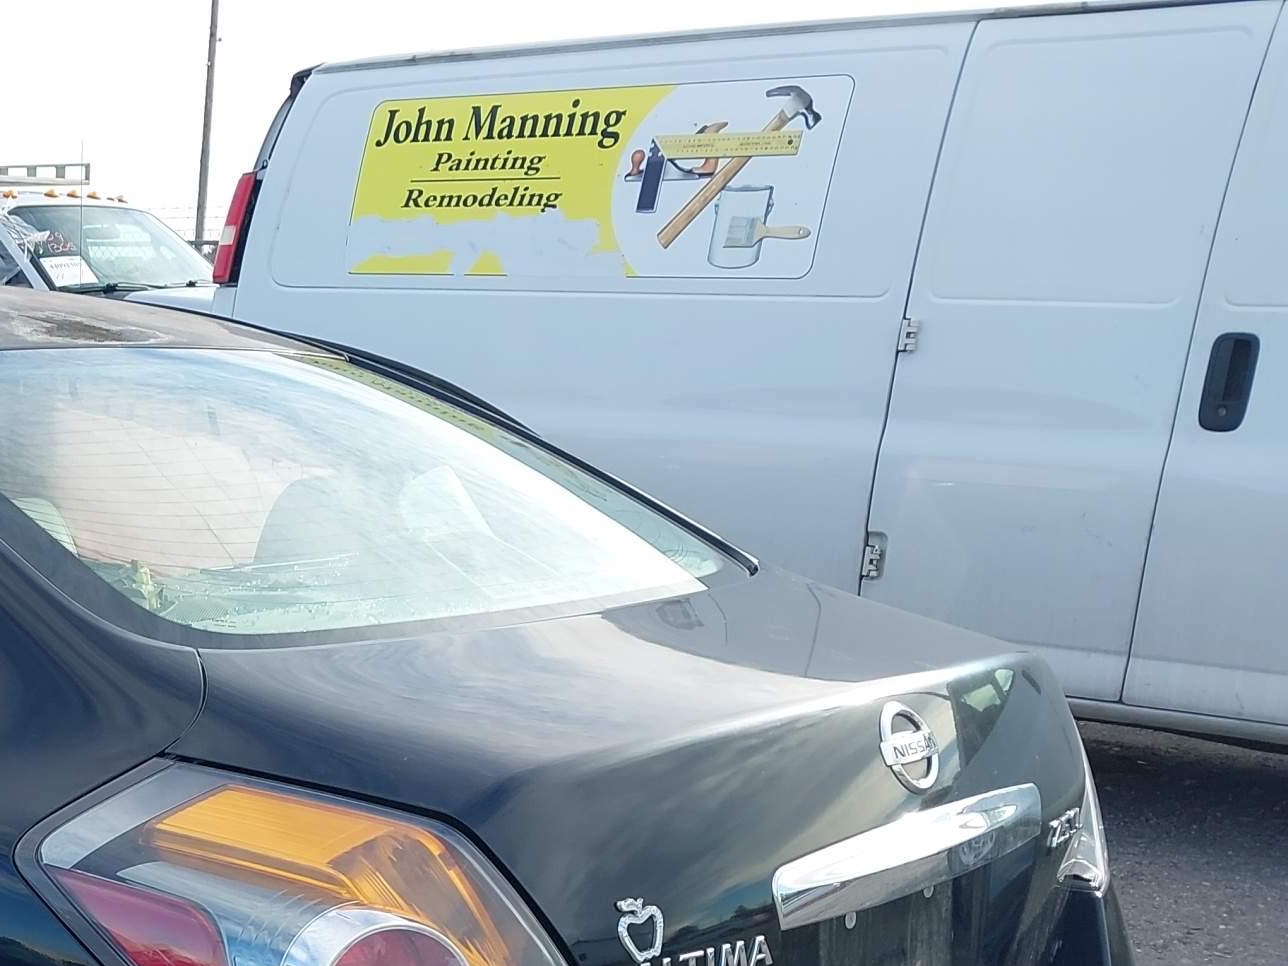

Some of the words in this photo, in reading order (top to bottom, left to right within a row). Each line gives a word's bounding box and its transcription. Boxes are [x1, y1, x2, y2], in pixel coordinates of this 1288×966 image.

[375, 106, 455, 147] John
[462, 98, 627, 149] Manning
[430, 150, 546, 176] Painting
[401, 186, 563, 213] Remodeling
[892, 732, 938, 760] NISSAN
